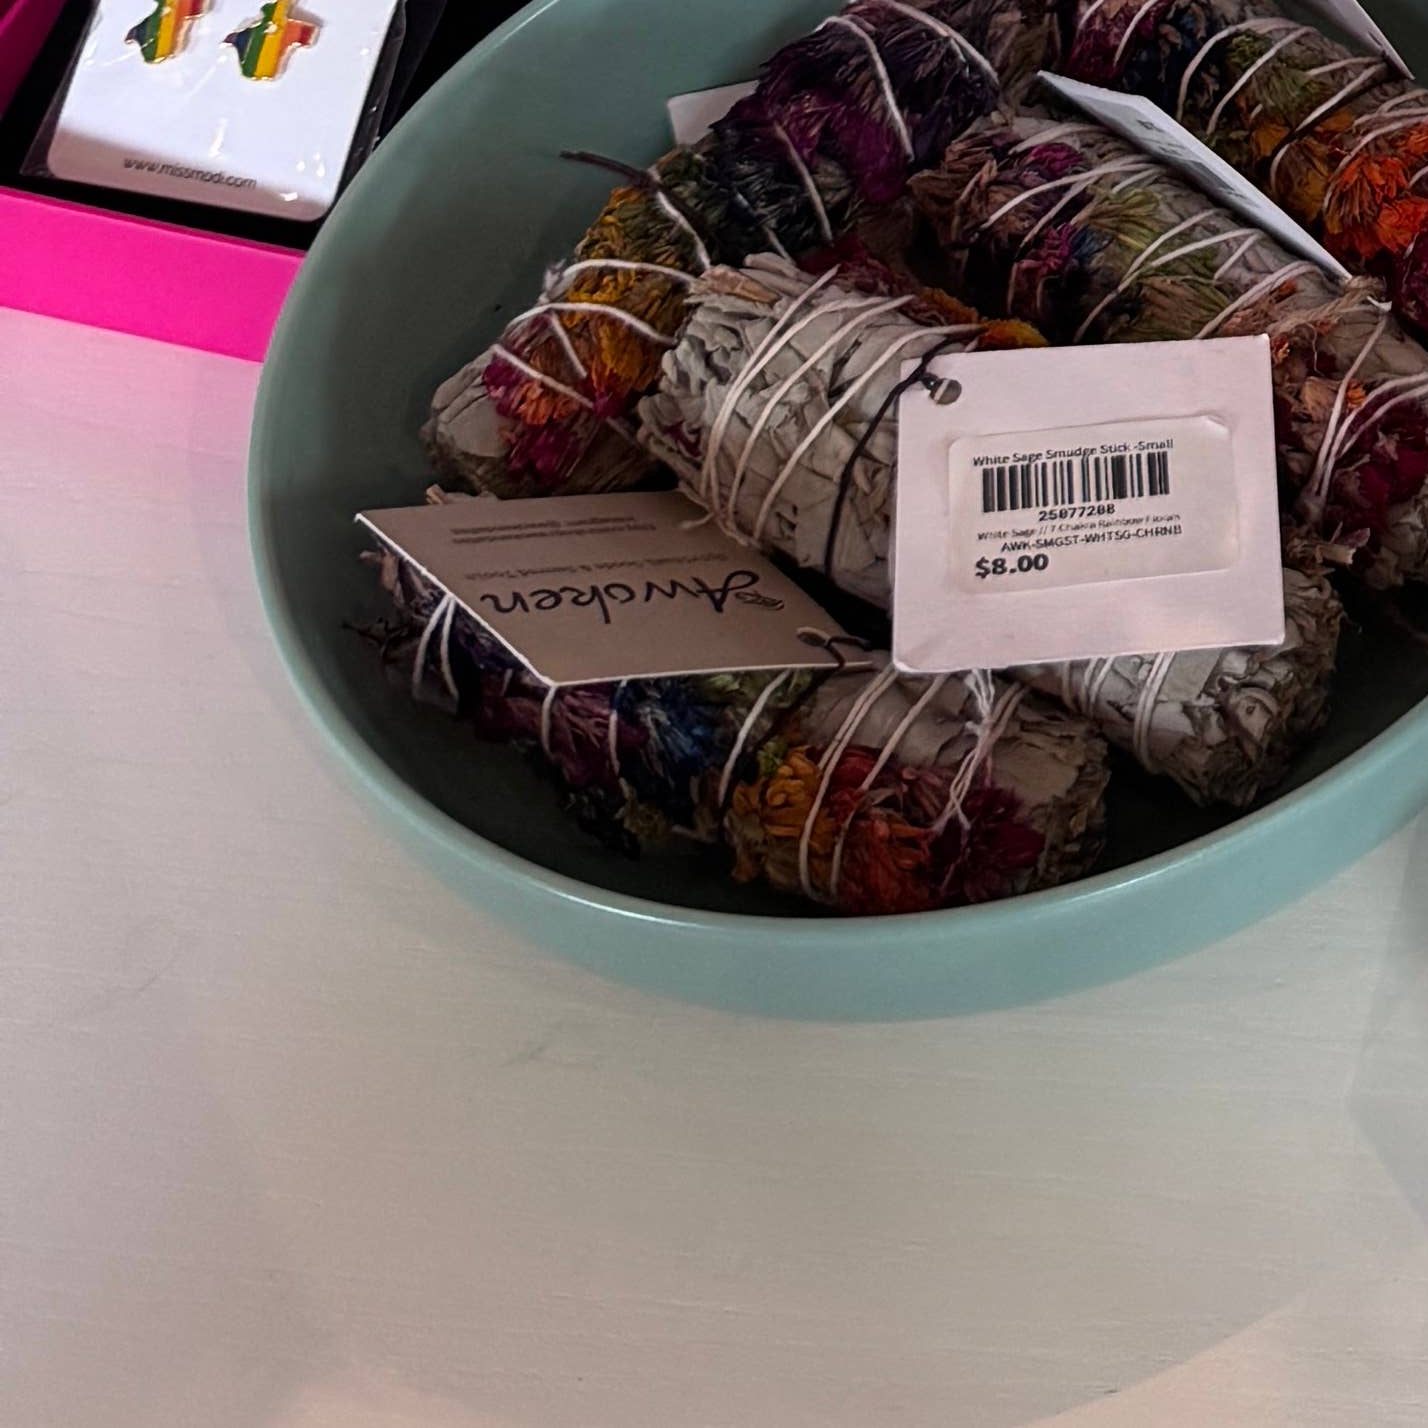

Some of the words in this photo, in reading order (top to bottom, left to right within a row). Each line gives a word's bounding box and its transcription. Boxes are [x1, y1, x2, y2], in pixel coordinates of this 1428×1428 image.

[123, 156, 258, 190] www.missmodi.com
[973, 455, 1010, 467] White
[1012, 451, 1043, 464] Sage
[1045, 446, 1097, 461] Smudge
[1100, 442, 1131, 454] Stick
[975, 553, 1050, 579] $8.00
